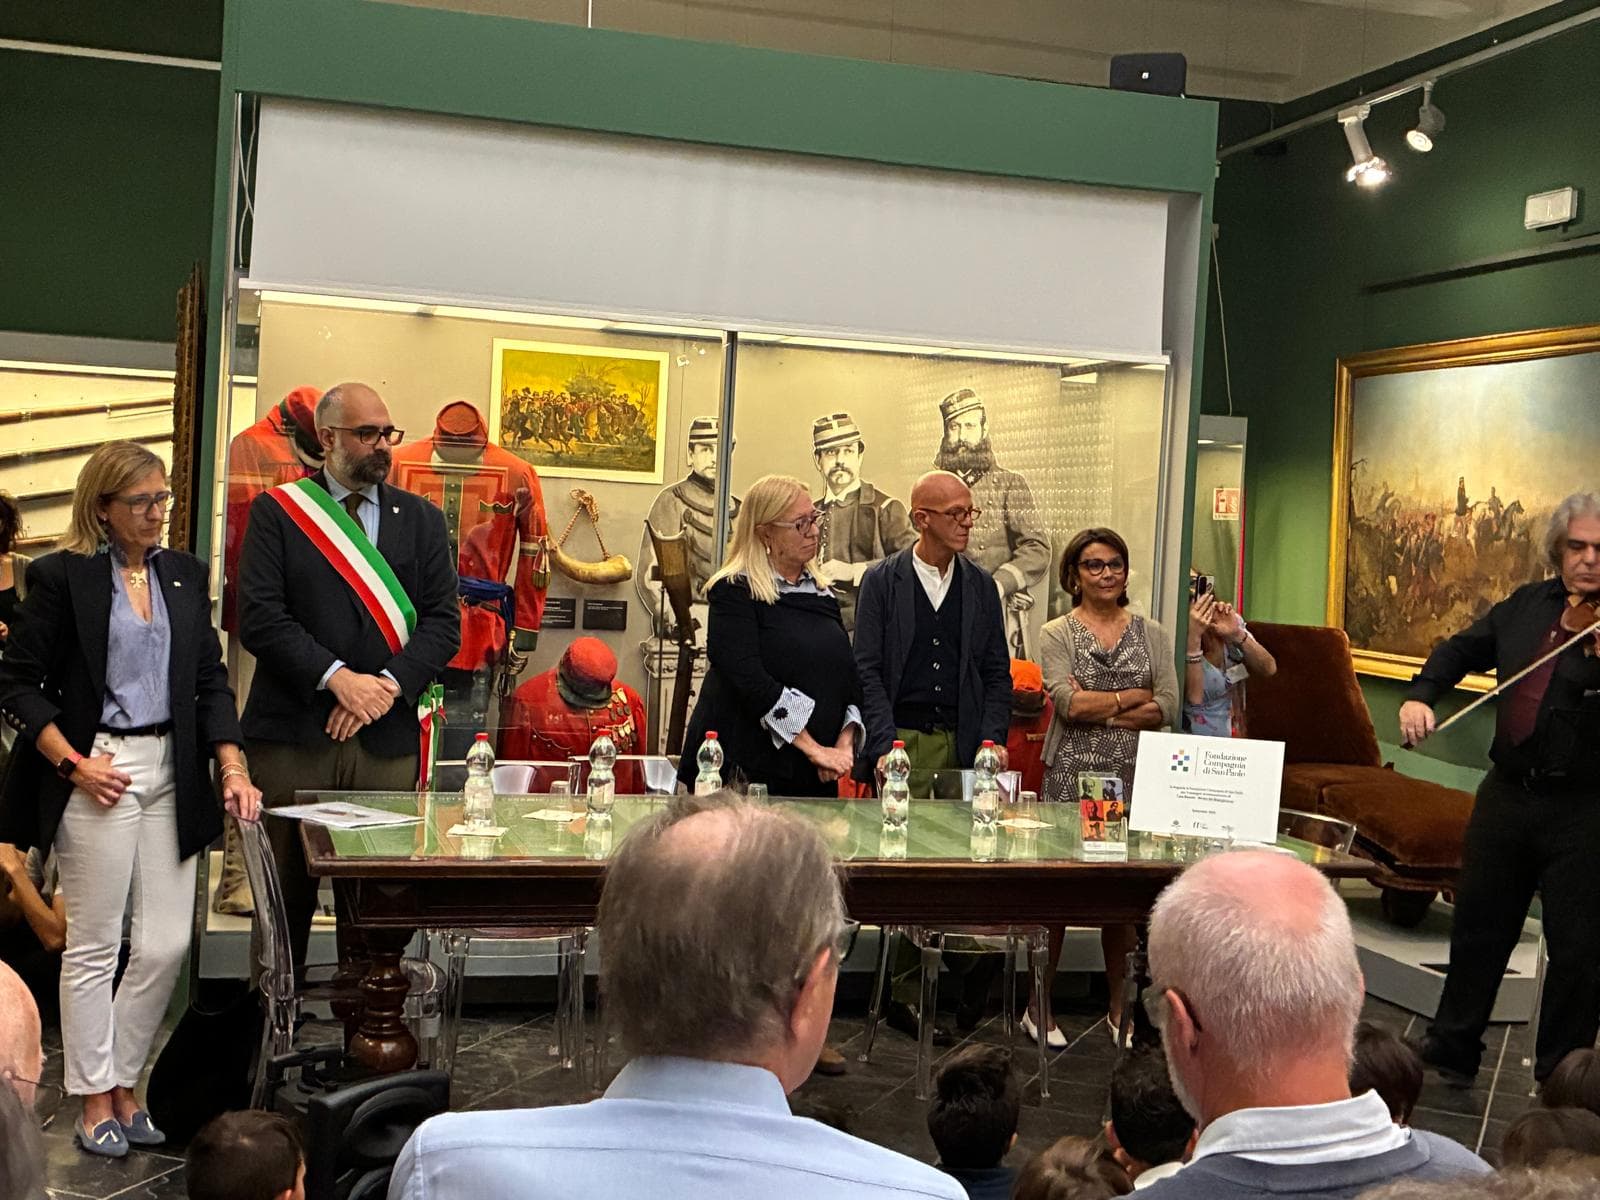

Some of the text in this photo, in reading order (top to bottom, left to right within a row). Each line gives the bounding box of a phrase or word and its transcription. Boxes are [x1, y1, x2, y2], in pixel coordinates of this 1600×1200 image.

[1205, 751, 1247, 761] Fondazione
[1203, 759, 1246, 769] Compagnia
[1202, 767, 1246, 777] di San Paolo
